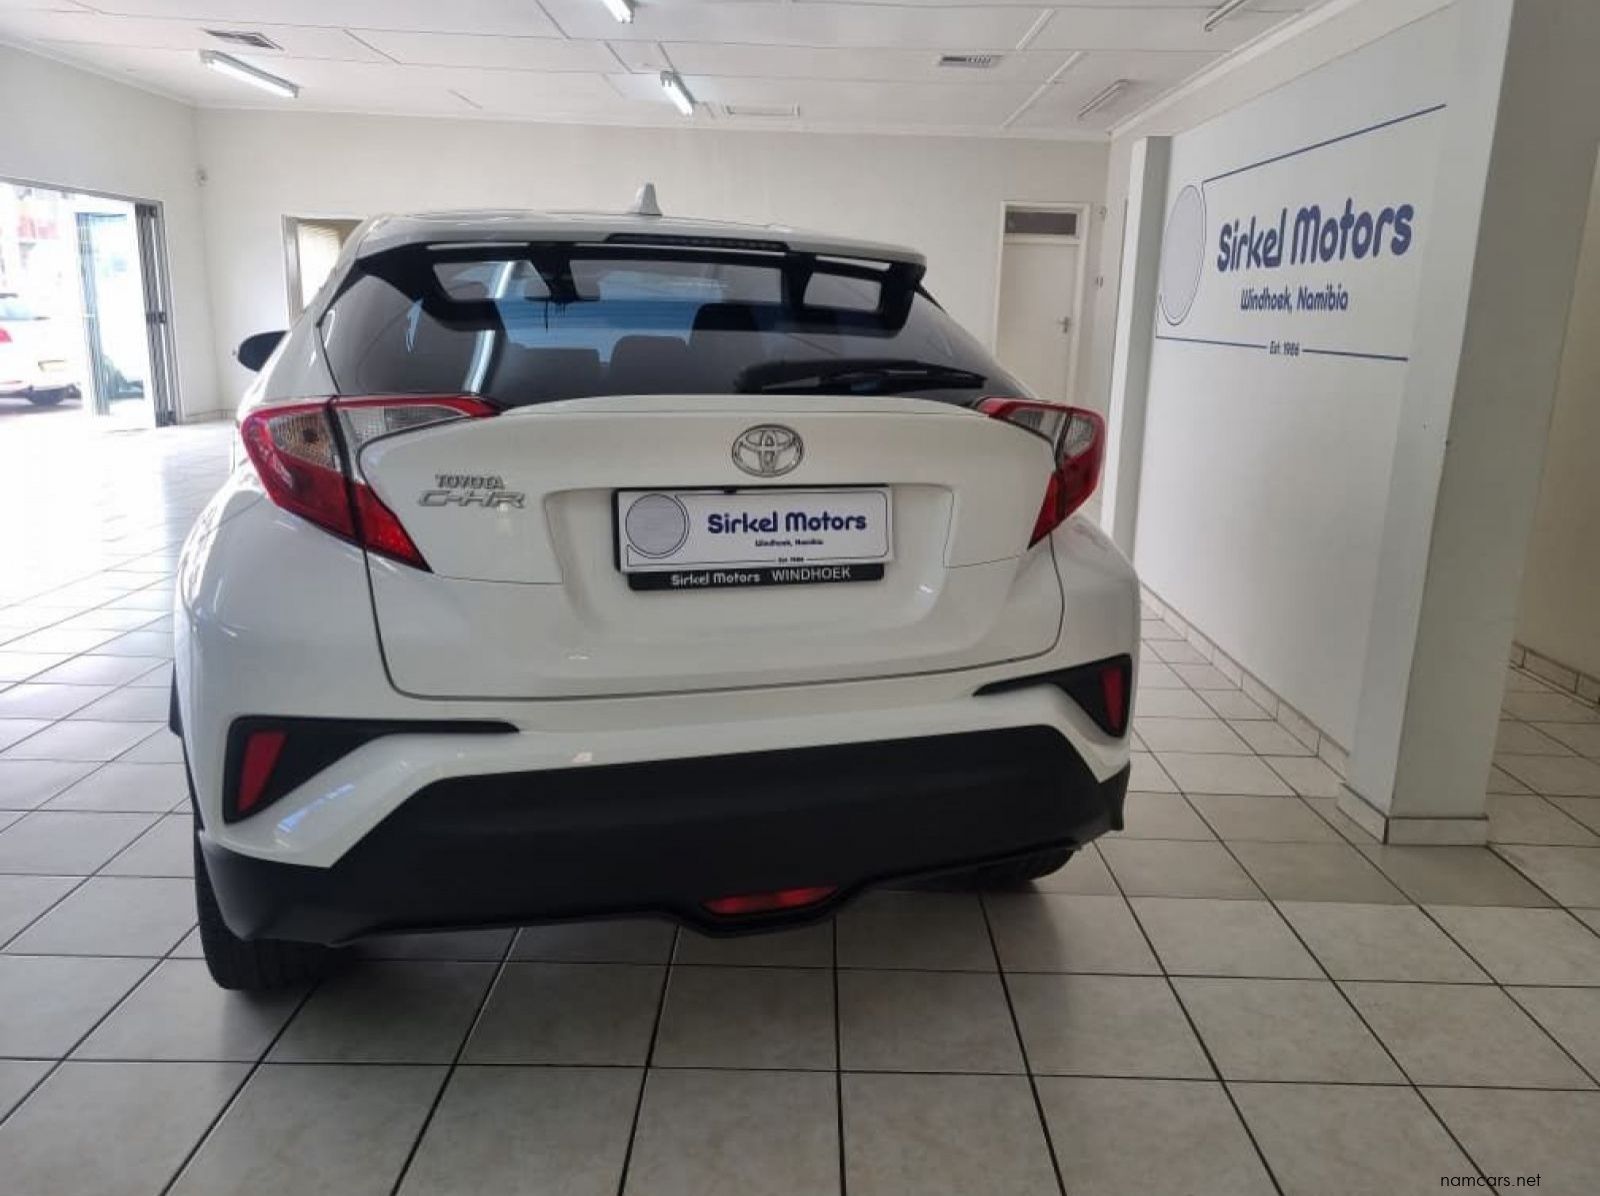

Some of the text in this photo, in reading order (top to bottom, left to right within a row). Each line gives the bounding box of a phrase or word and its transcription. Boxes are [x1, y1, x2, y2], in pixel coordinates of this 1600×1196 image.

[1217, 198, 1414, 272] Sirkel Motors
[1240, 283, 1348, 313] Windhoek, Namibia
[435, 474, 505, 490] TOYOTA
[707, 511, 867, 534] Sirkel Motors
[671, 567, 851, 586] Sirkel Motors WINDHOEK
